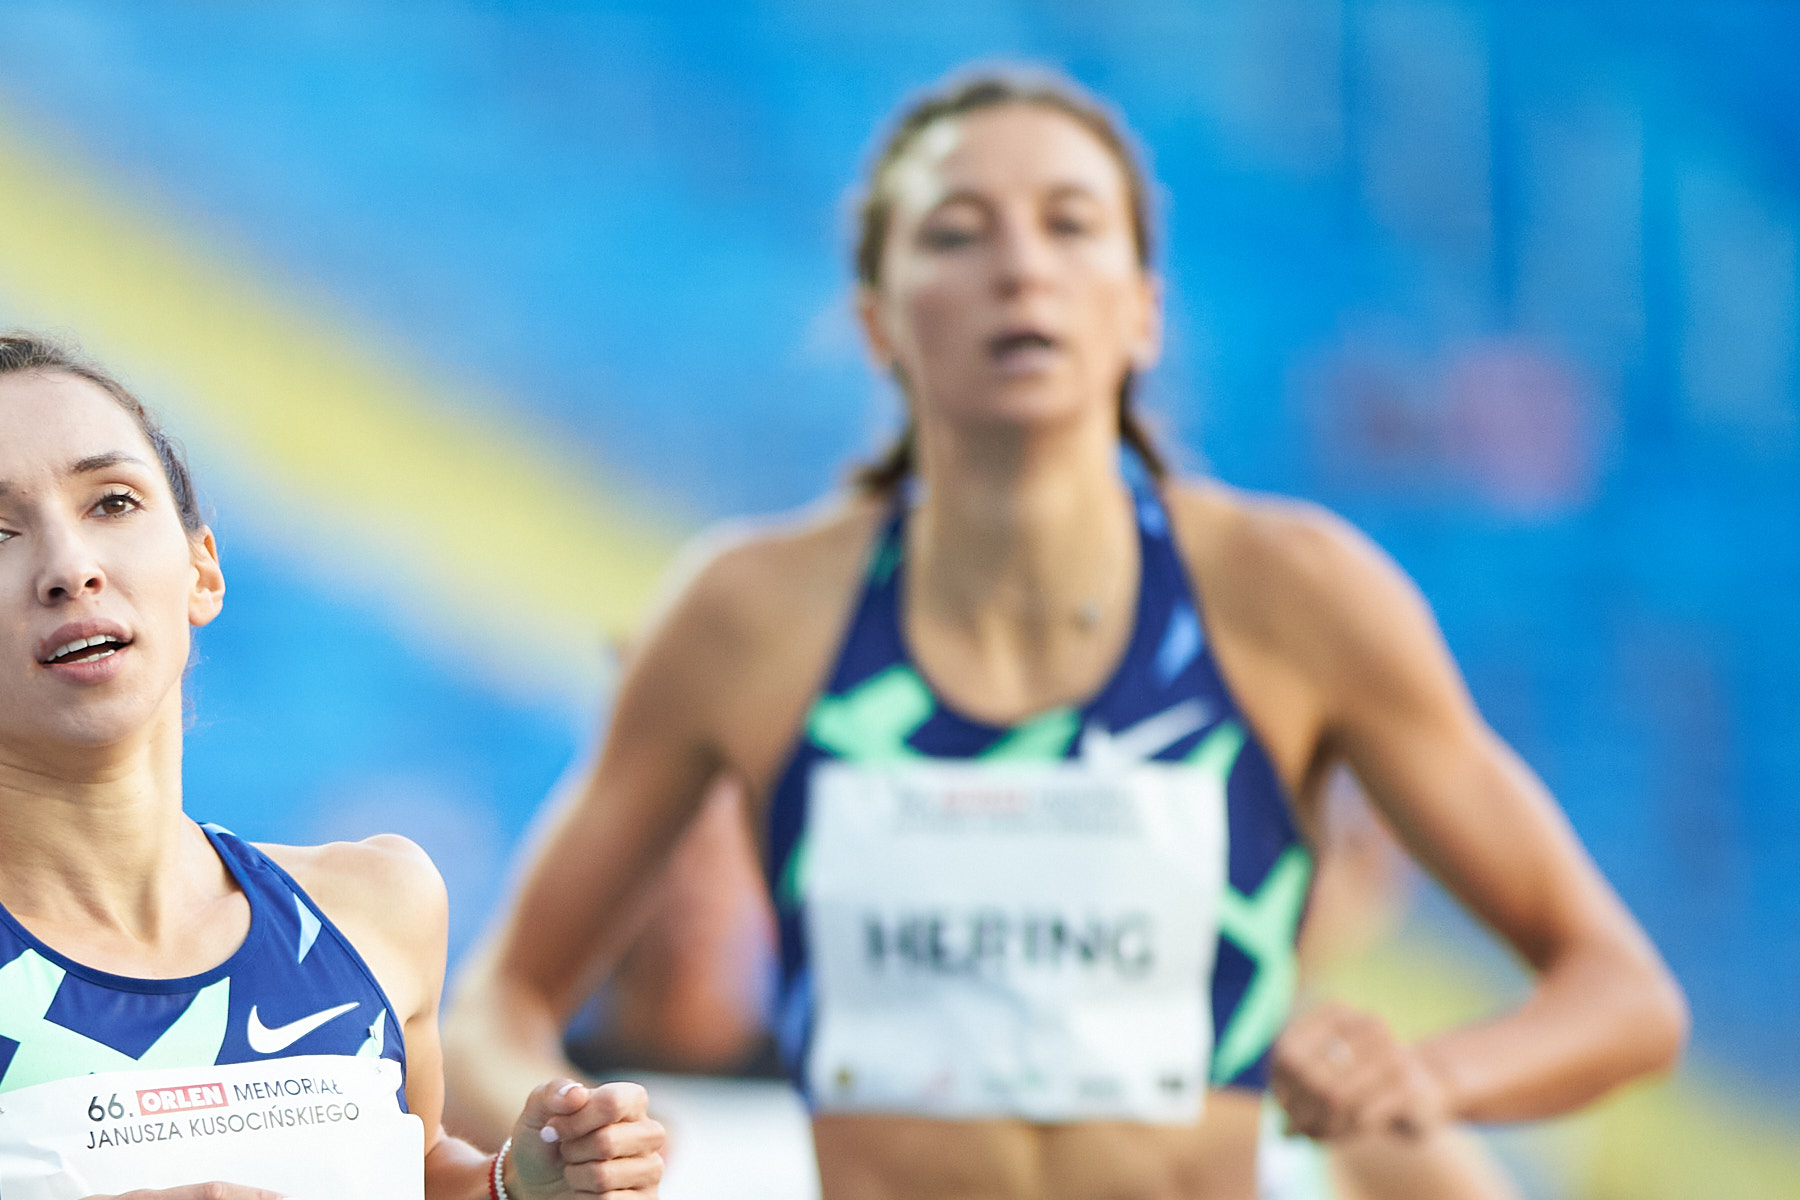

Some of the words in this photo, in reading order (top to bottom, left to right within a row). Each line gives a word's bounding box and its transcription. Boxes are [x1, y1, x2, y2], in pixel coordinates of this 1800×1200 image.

[87, 1093, 134, 1122] 66.
[140, 1085, 225, 1112] ORLEN
[233, 1078, 344, 1101] MEMORIAŁ
[86, 1121, 183, 1150] JANUSZA
[188, 1102, 360, 1137] KUSOCIŃSKIEGO
